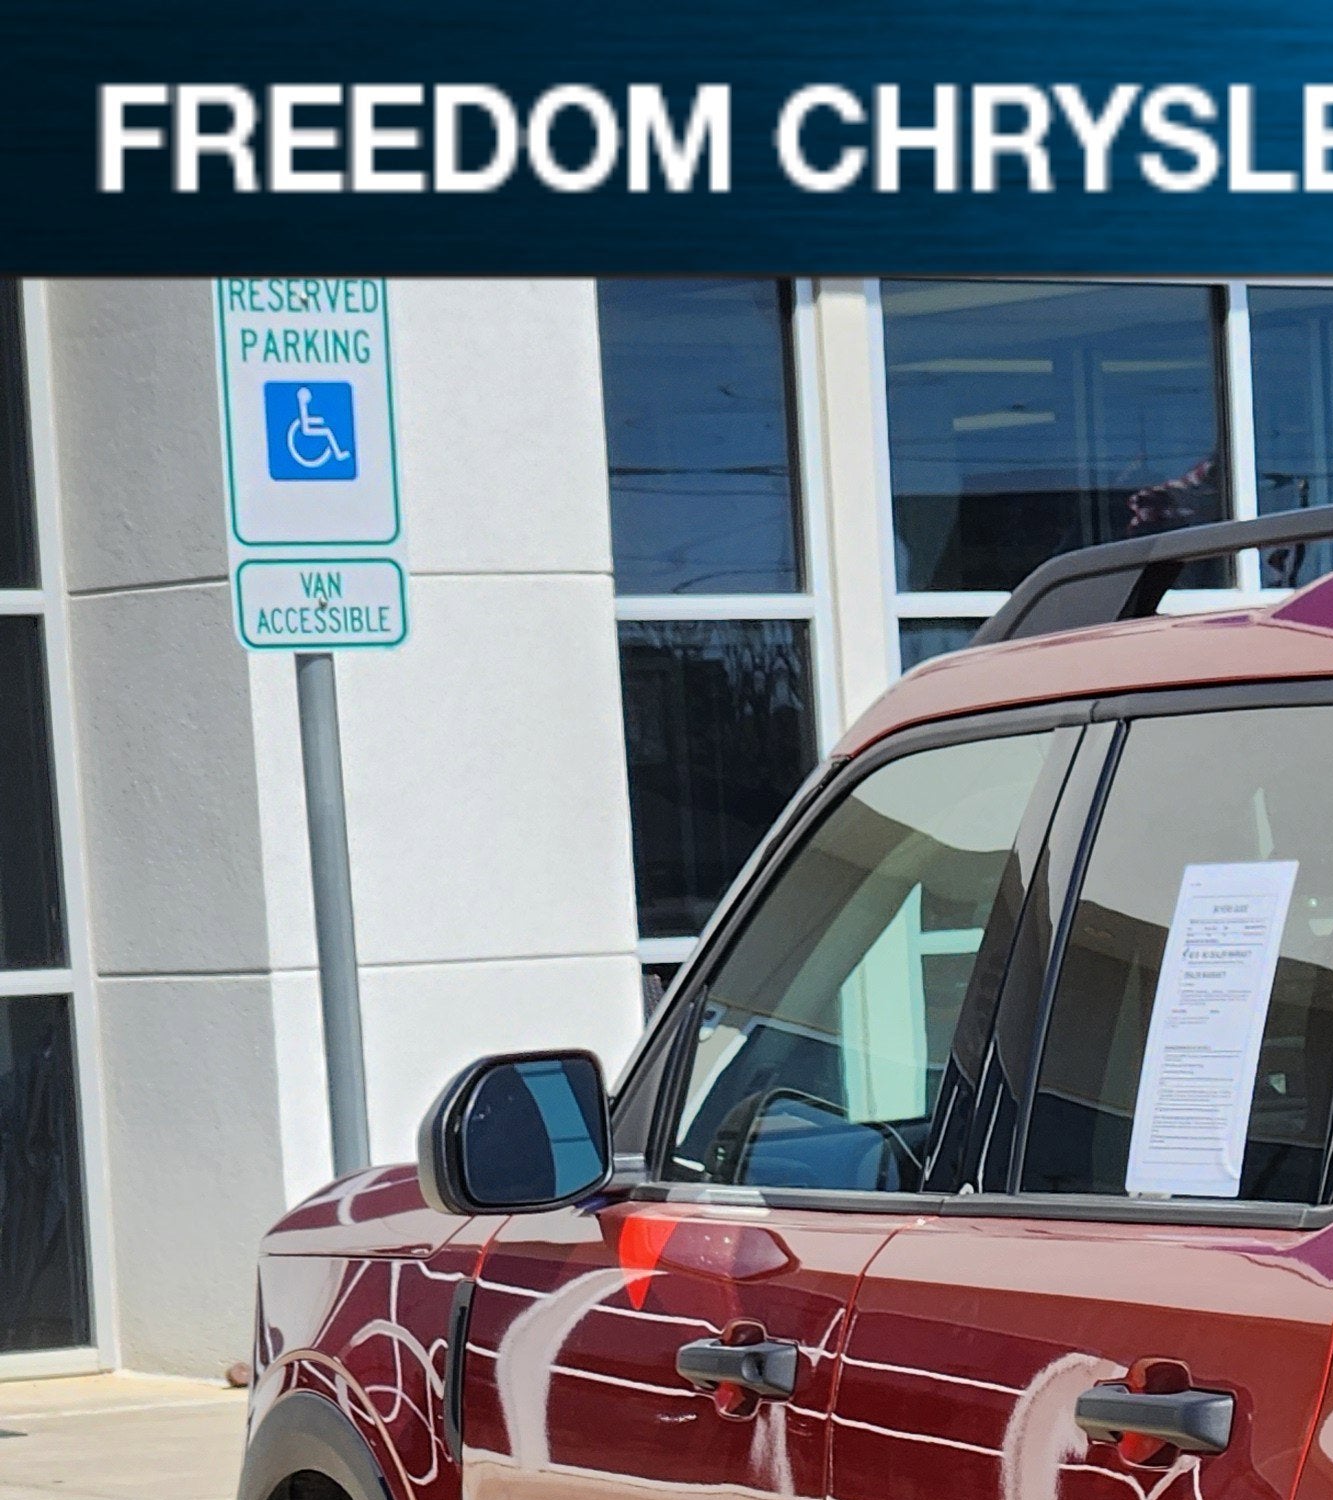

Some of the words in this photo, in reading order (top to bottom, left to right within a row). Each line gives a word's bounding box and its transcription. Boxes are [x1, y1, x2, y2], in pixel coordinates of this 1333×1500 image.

[228, 278, 380, 314] RESERVED
[240, 328, 372, 364] PARKING
[299, 570, 342, 600] VAN
[256, 605, 392, 635] ACCESSIBLE
